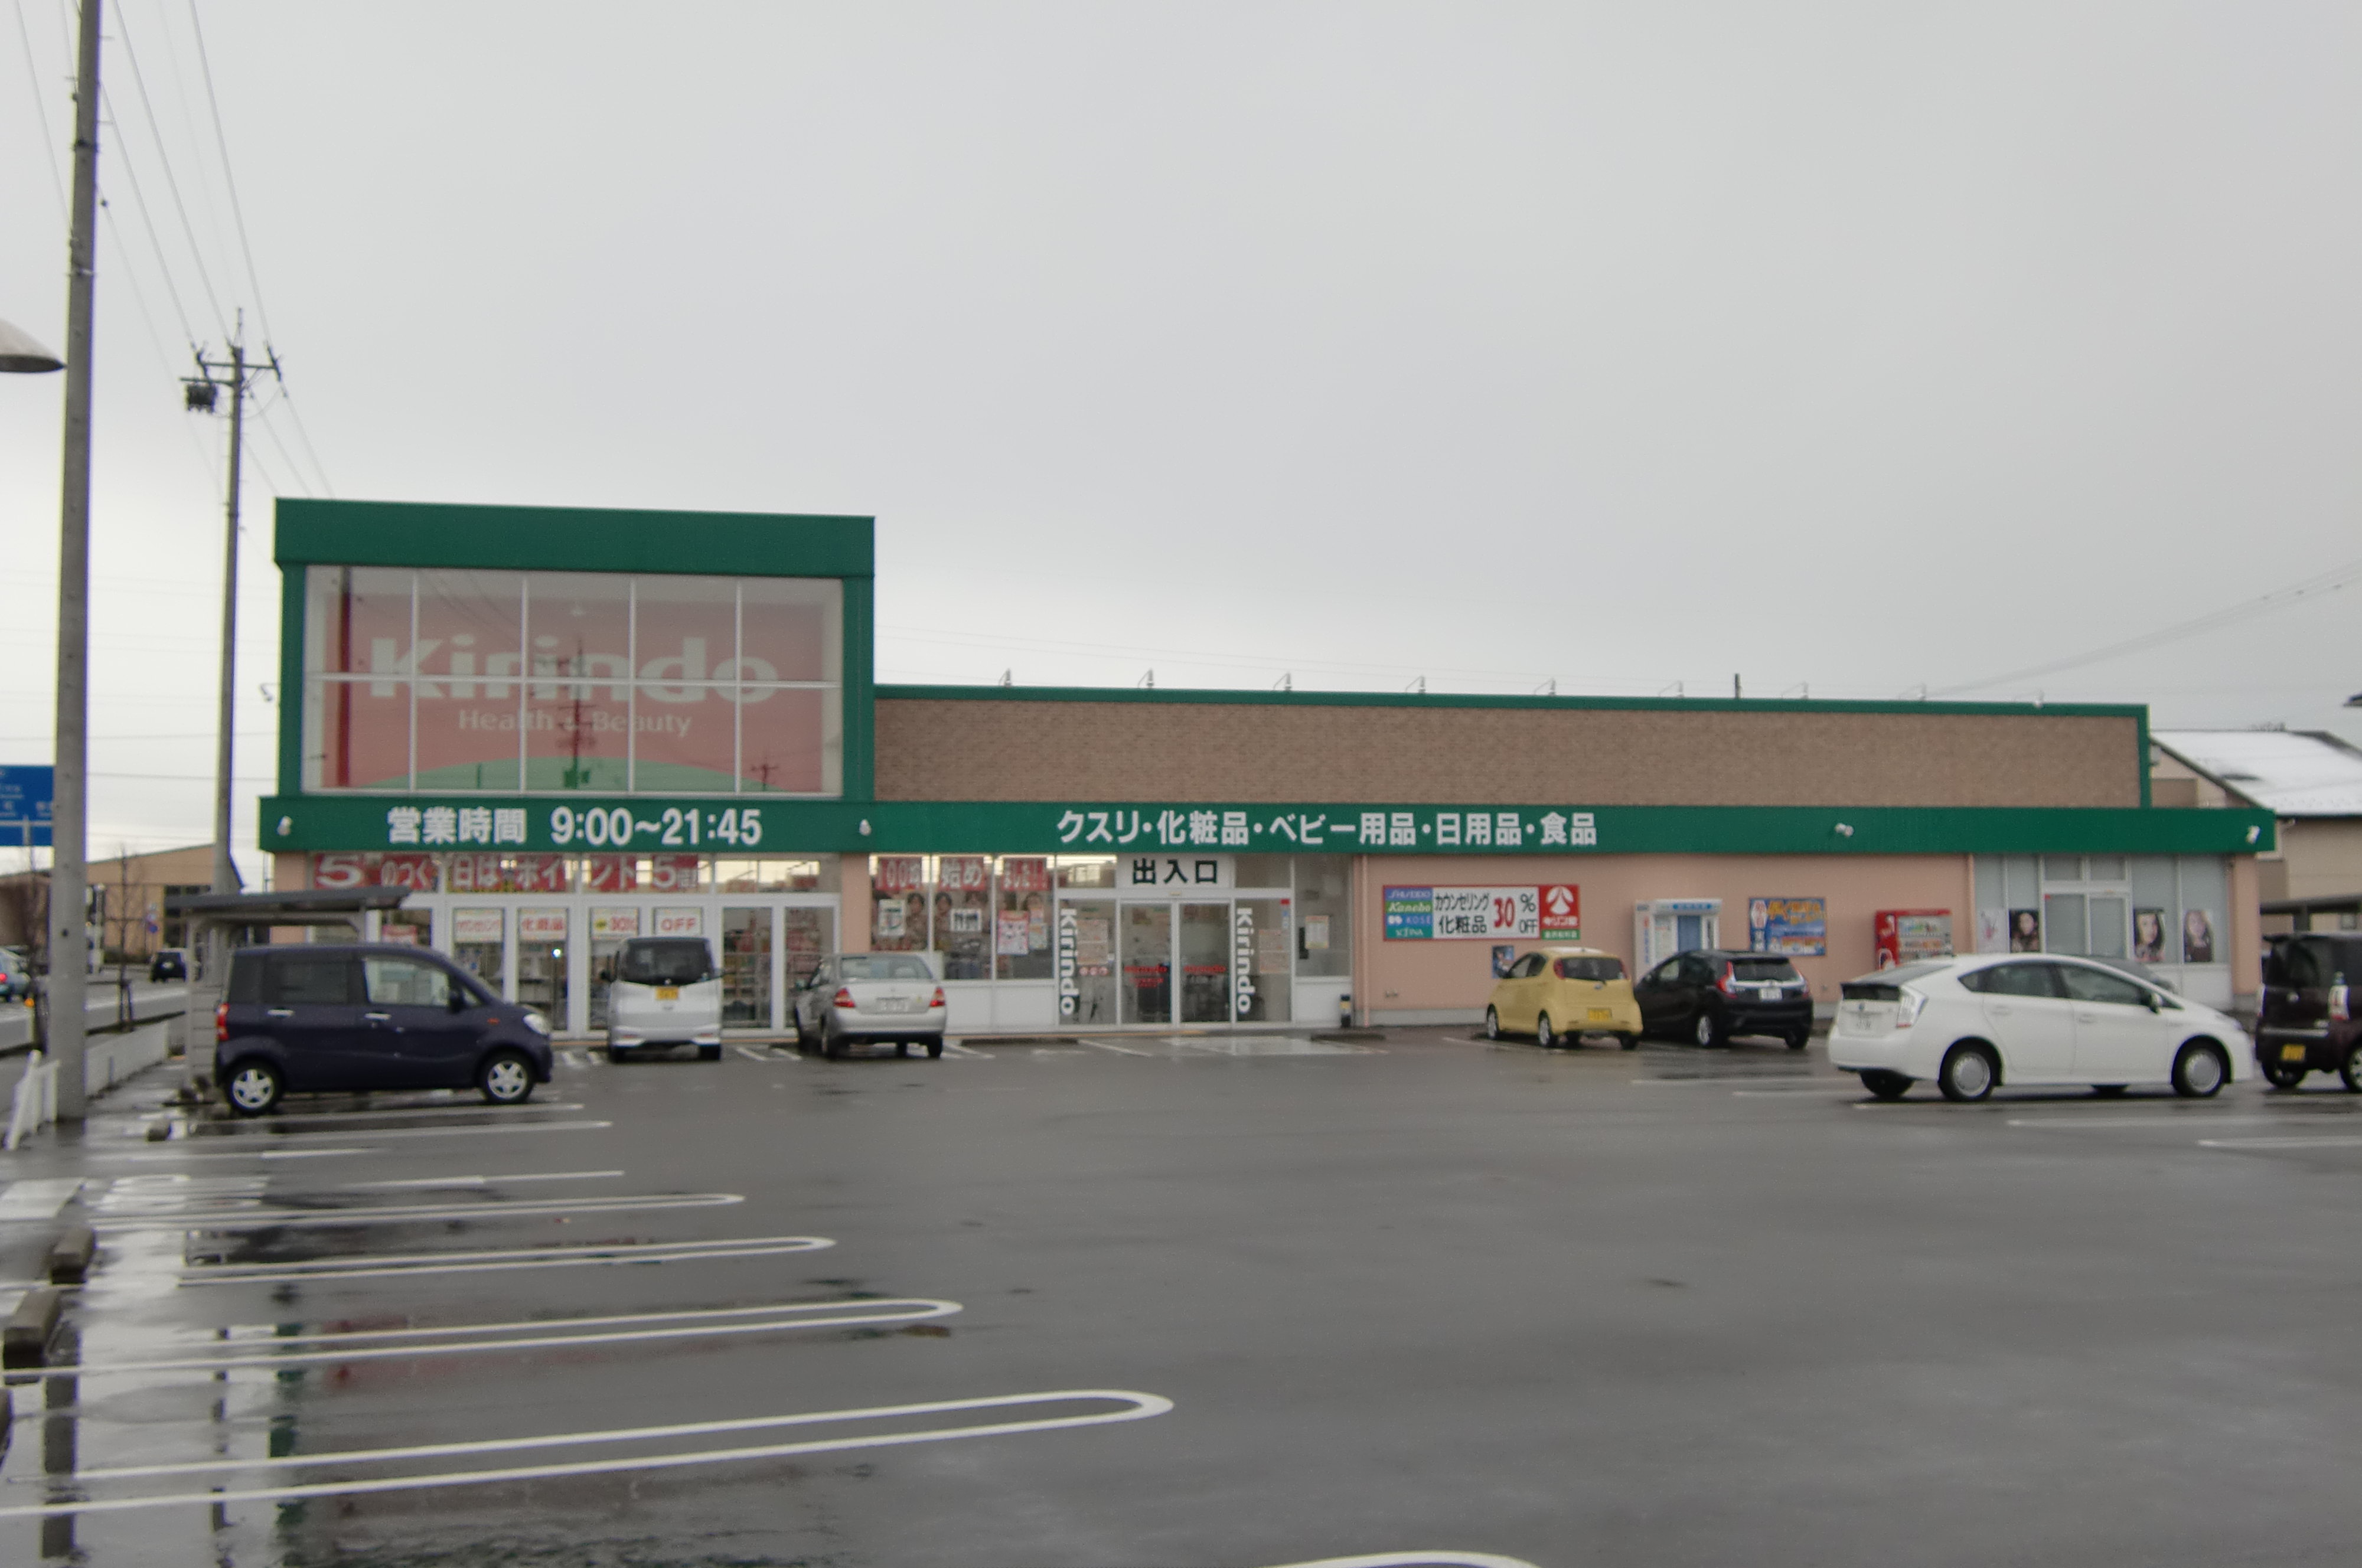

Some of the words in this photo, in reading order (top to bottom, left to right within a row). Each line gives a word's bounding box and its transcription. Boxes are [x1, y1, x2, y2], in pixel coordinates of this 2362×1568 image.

[370, 633, 779, 704] Kirindo
[592, 711, 691, 737] Beauty
[387, 806, 527, 845] 営業時間
[550, 806, 762, 845] 9:00~21:45
[1133, 858, 1218, 884] 出入口
[1388, 901, 1431, 913] Kanebo
[1435, 893, 1490, 911] カウンセリング
[1493, 896, 1515, 928] 30
[1520, 893, 1536, 913] %
[659, 918, 697, 931] OFF
[1439, 916, 1487, 934] 化粧品
[1060, 908, 1080, 1015] Kirindo
[1237, 907, 1256, 1014] Kirindo
